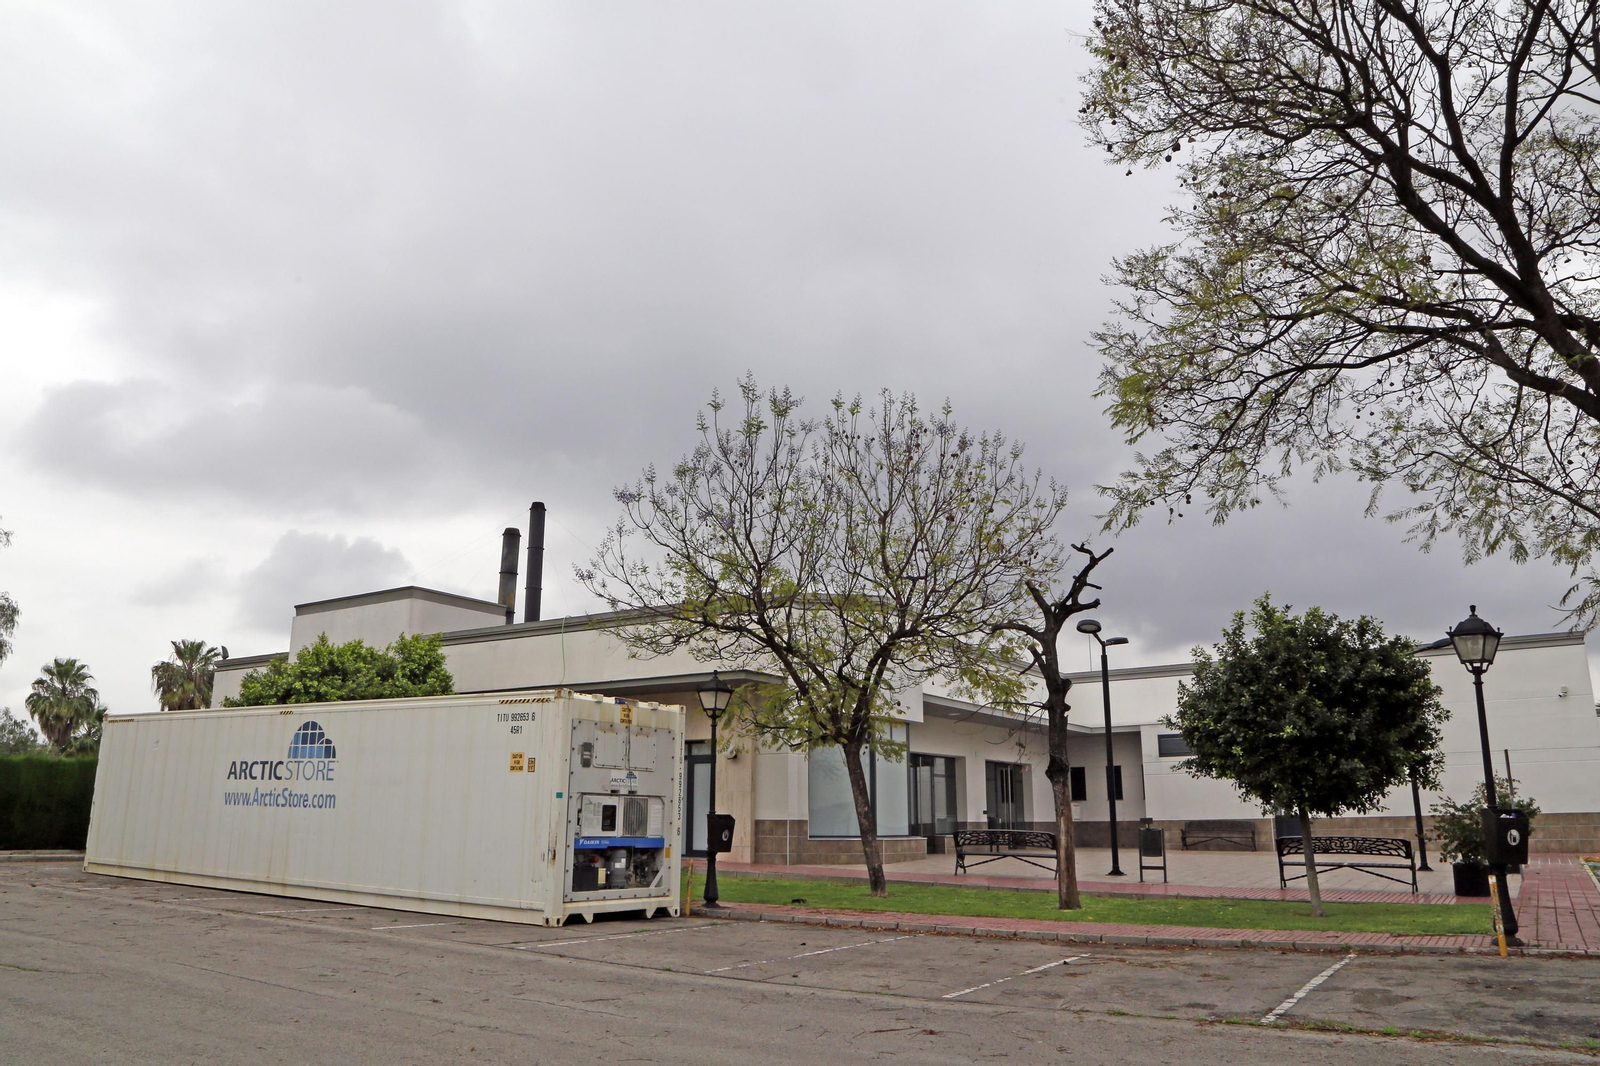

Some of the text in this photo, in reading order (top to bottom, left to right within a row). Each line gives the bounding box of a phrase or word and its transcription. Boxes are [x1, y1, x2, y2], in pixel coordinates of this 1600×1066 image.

[497, 712, 536, 722] TITU 992653 6
[510, 725, 523, 734] 45R1
[227, 760, 336, 781] ARCTICSTORE
[224, 787, 337, 809] www.ArcticStore.com
